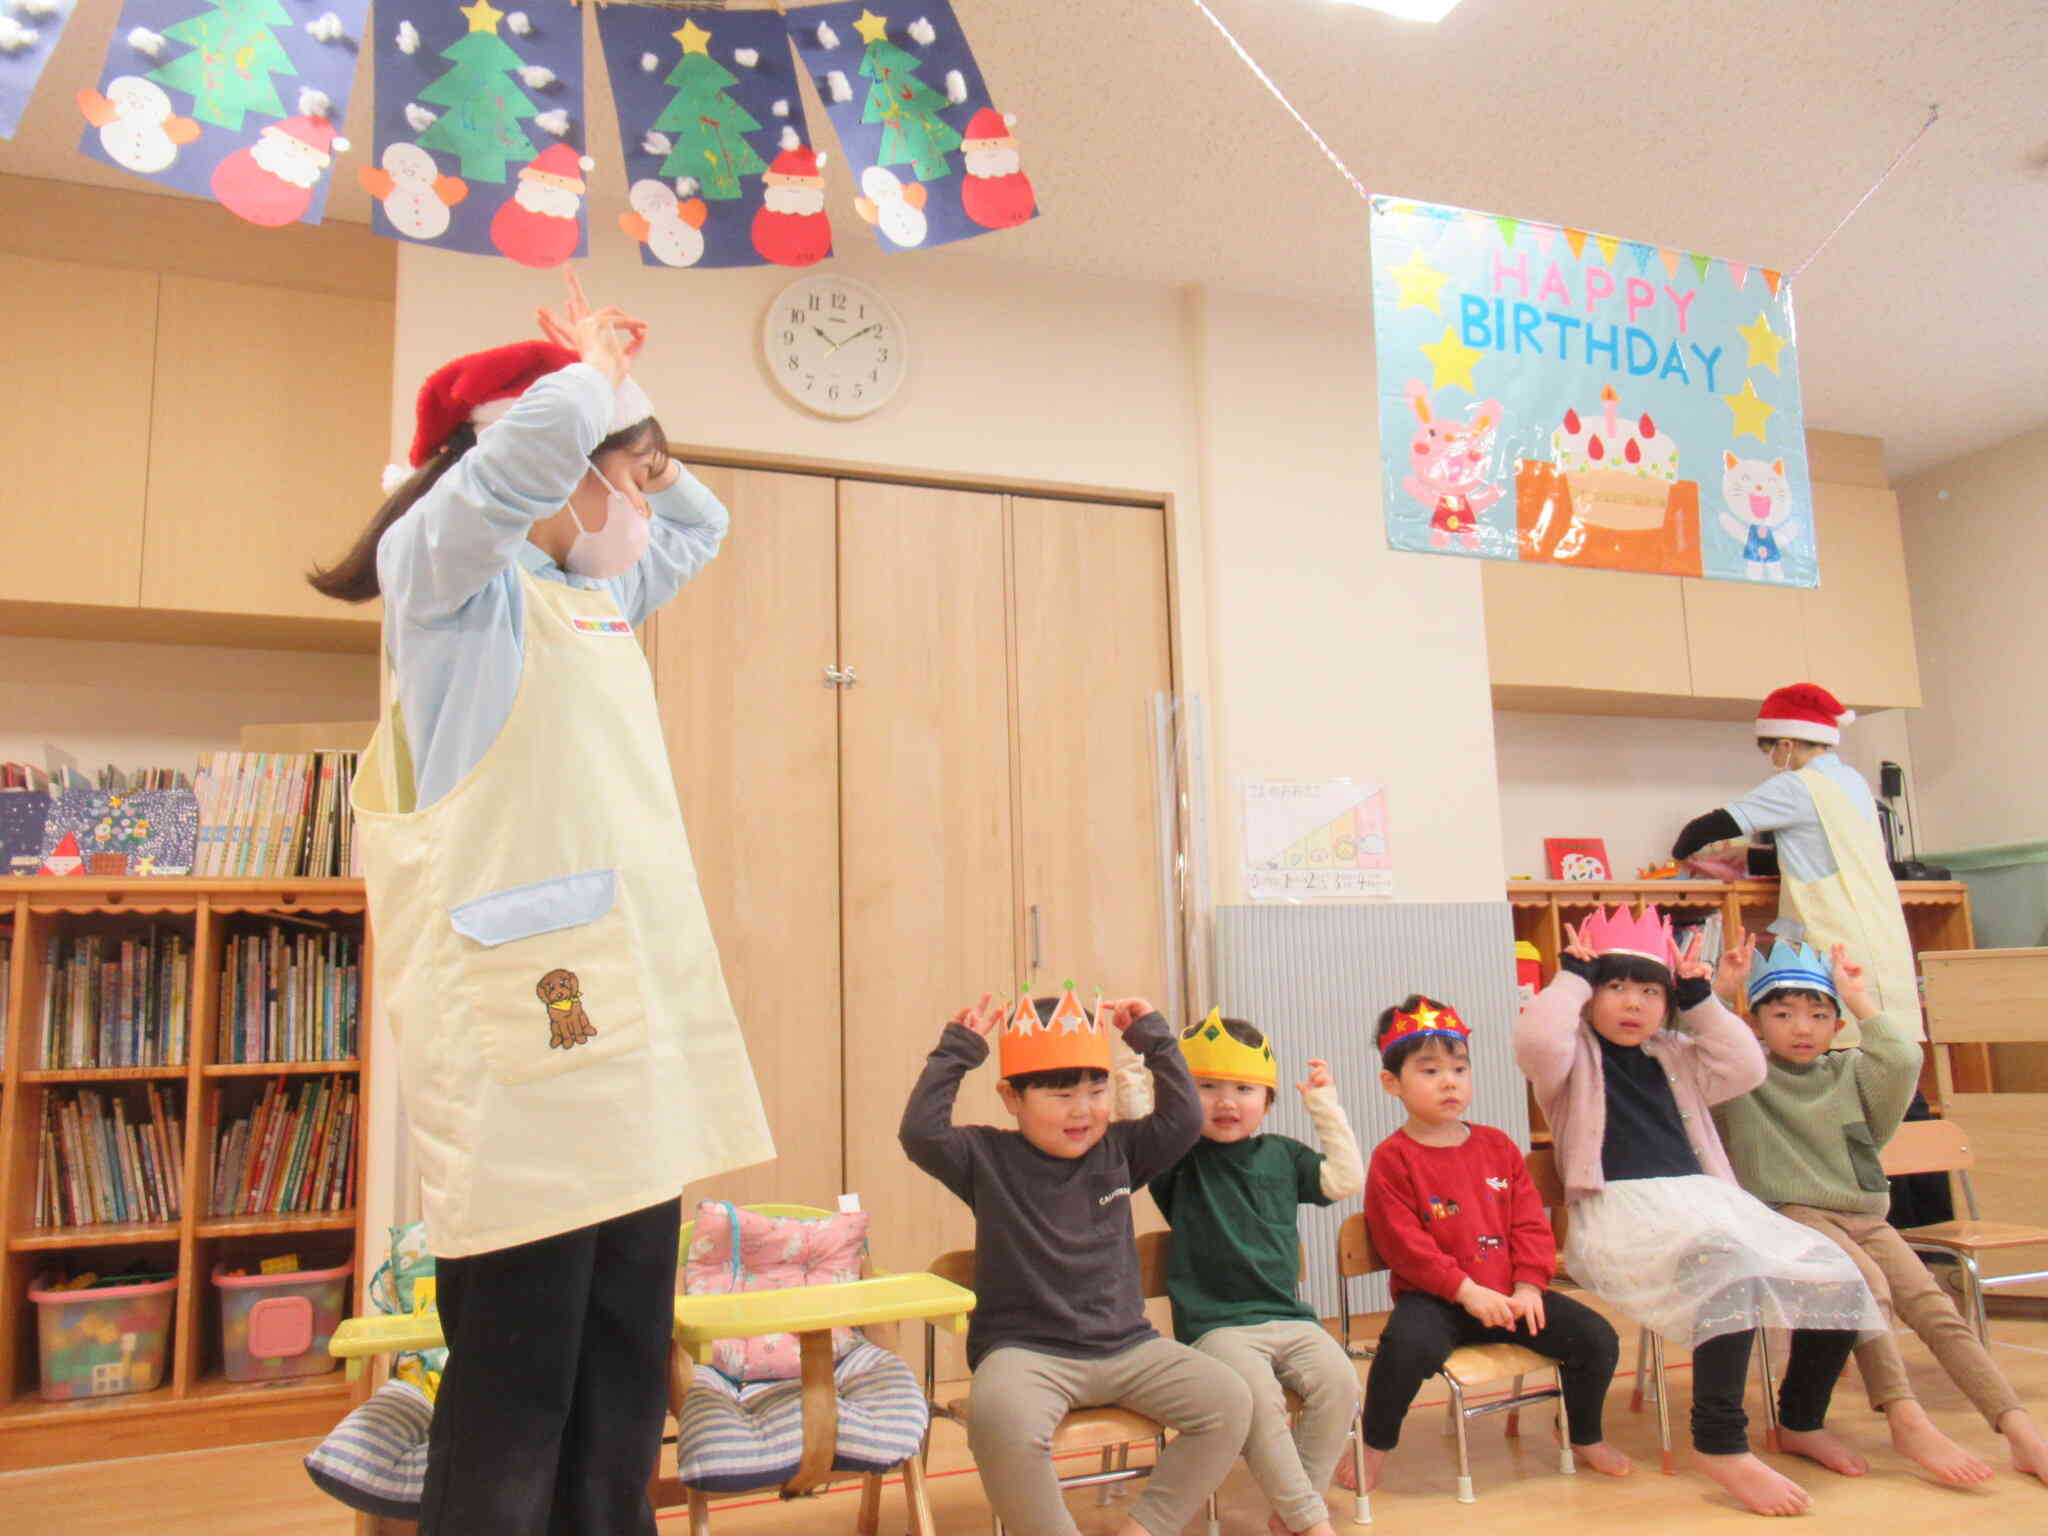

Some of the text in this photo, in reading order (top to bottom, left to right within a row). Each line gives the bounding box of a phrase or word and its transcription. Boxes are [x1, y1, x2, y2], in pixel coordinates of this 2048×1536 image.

[1492, 249, 1697, 334] HAPPY
[809, 293, 820, 311] 11
[831, 293, 847, 310] 12
[791, 308, 805, 324] 10
[783, 331, 794, 345] 9
[872, 323, 883, 339] 2
[1460, 292, 1723, 392] BIRTHDAY
[788, 355, 799, 370] 8
[878, 348, 888, 363] 3
[806, 373, 815, 390] 7
[828, 385, 839, 400] 6
[853, 384, 863, 399] 5
